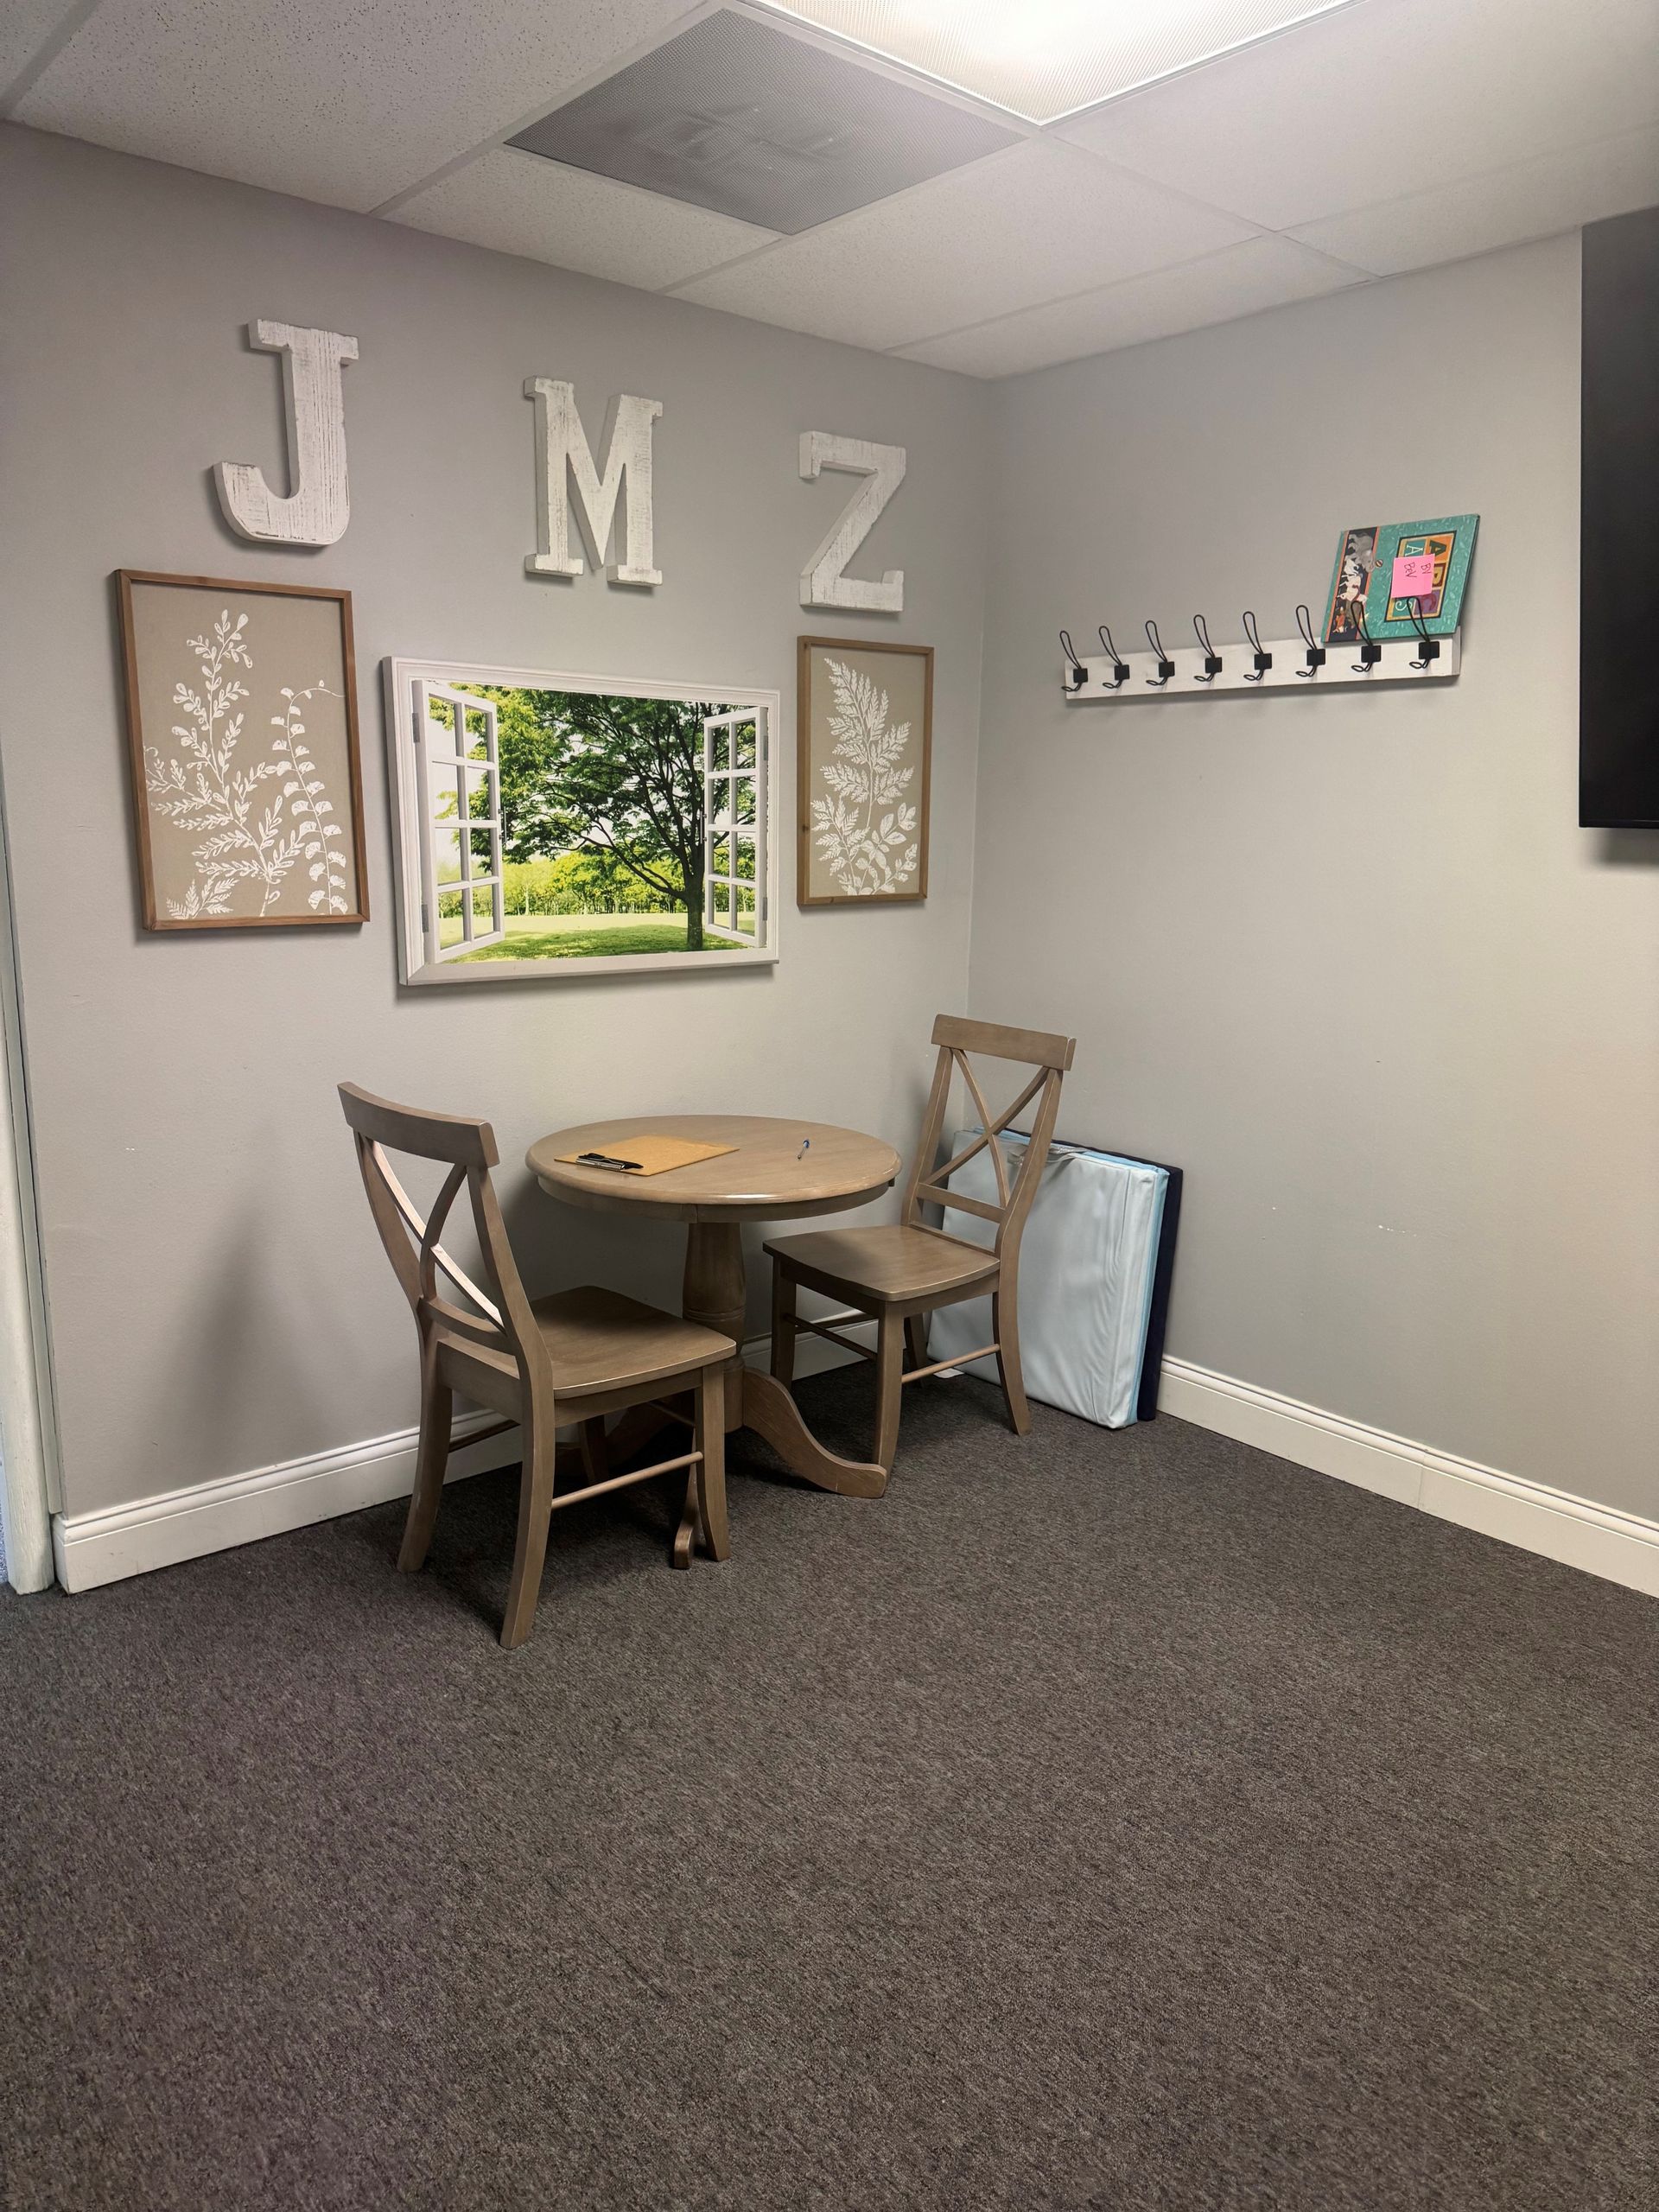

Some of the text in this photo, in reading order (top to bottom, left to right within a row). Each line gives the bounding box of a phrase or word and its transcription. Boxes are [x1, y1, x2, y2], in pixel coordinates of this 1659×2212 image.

[213, 319, 906, 613] J M Z
